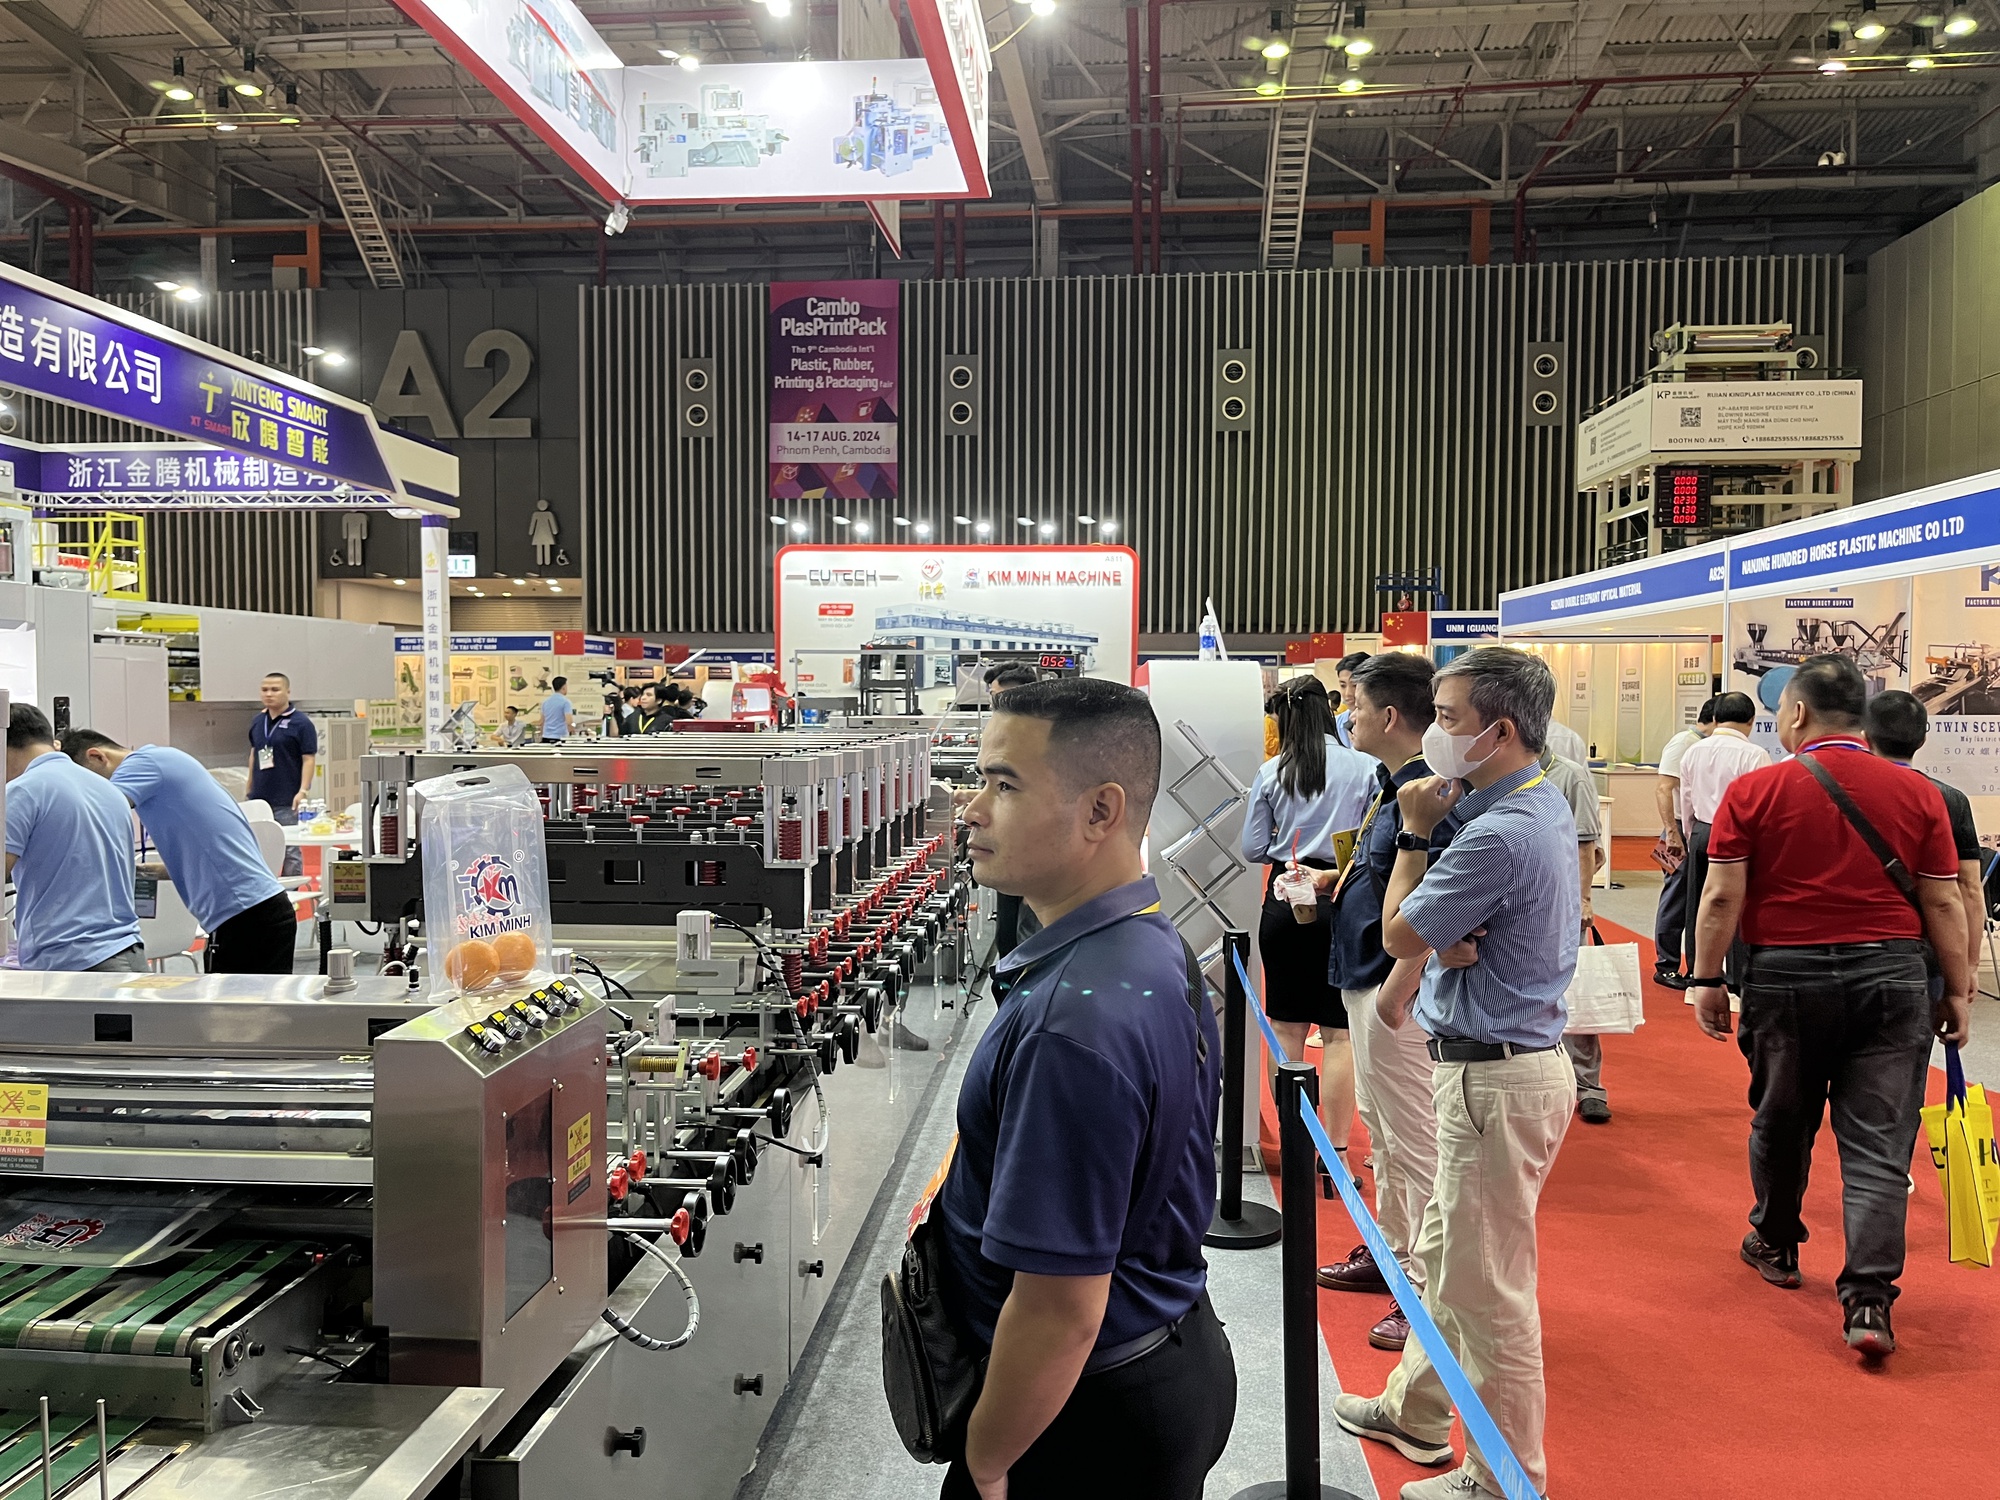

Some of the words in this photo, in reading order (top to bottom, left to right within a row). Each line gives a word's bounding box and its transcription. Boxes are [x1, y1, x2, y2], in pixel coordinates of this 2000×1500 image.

[806, 297, 860, 316] Cambo
[780, 317, 887, 337] PlasPrintPack
[0, 305, 162, 404] 造有限公司
[791, 346, 806, 354] The
[818, 346, 857, 354] Cambodia
[791, 358, 831, 373] Plastic,
[833, 358, 874, 373] Rubber,
[373, 329, 532, 438] A2
[774, 376, 814, 392] Printing
[815, 377, 824, 389] &
[826, 375, 878, 392] Packaging
[231, 375, 283, 413] XINTENG
[287, 396, 328, 428] SMART
[1656, 390, 1671, 399] KP
[204, 419, 231, 437] SMART
[231, 410, 329, 465] 欣腾智能
[786, 431, 820, 442] 14-17
[821, 431, 850, 442] AUG.
[852, 431, 881, 442] 2024
[776, 445, 810, 455] Phnom
[812, 445, 840, 456] Penh,
[842, 445, 890, 455] Cambodia
[1741, 556, 1770, 576] NANJING
[1771, 547, 1808, 569] HUNDRED
[1809, 540, 1838, 563] HORSE
[1839, 534, 1877, 556] PLASTIC
[1878, 524, 1922, 549] MACHINE
[1925, 521, 1940, 541] CO
[1942, 515, 1964, 537] LTD
[452, 559, 470, 570] IT
[987, 570, 1012, 584] KIM
[1017, 570, 1050, 584] MINH
[1056, 570, 1122, 585] MACHINE
[1709, 566, 1724, 582] A829
[1832, 599, 1853, 607] SUPPLY
[1445, 624, 1465, 633] UNM
[1935, 721, 1968, 733] TWIN
[469, 922, 496, 938] KIM
[499, 914, 531, 933] MINH
